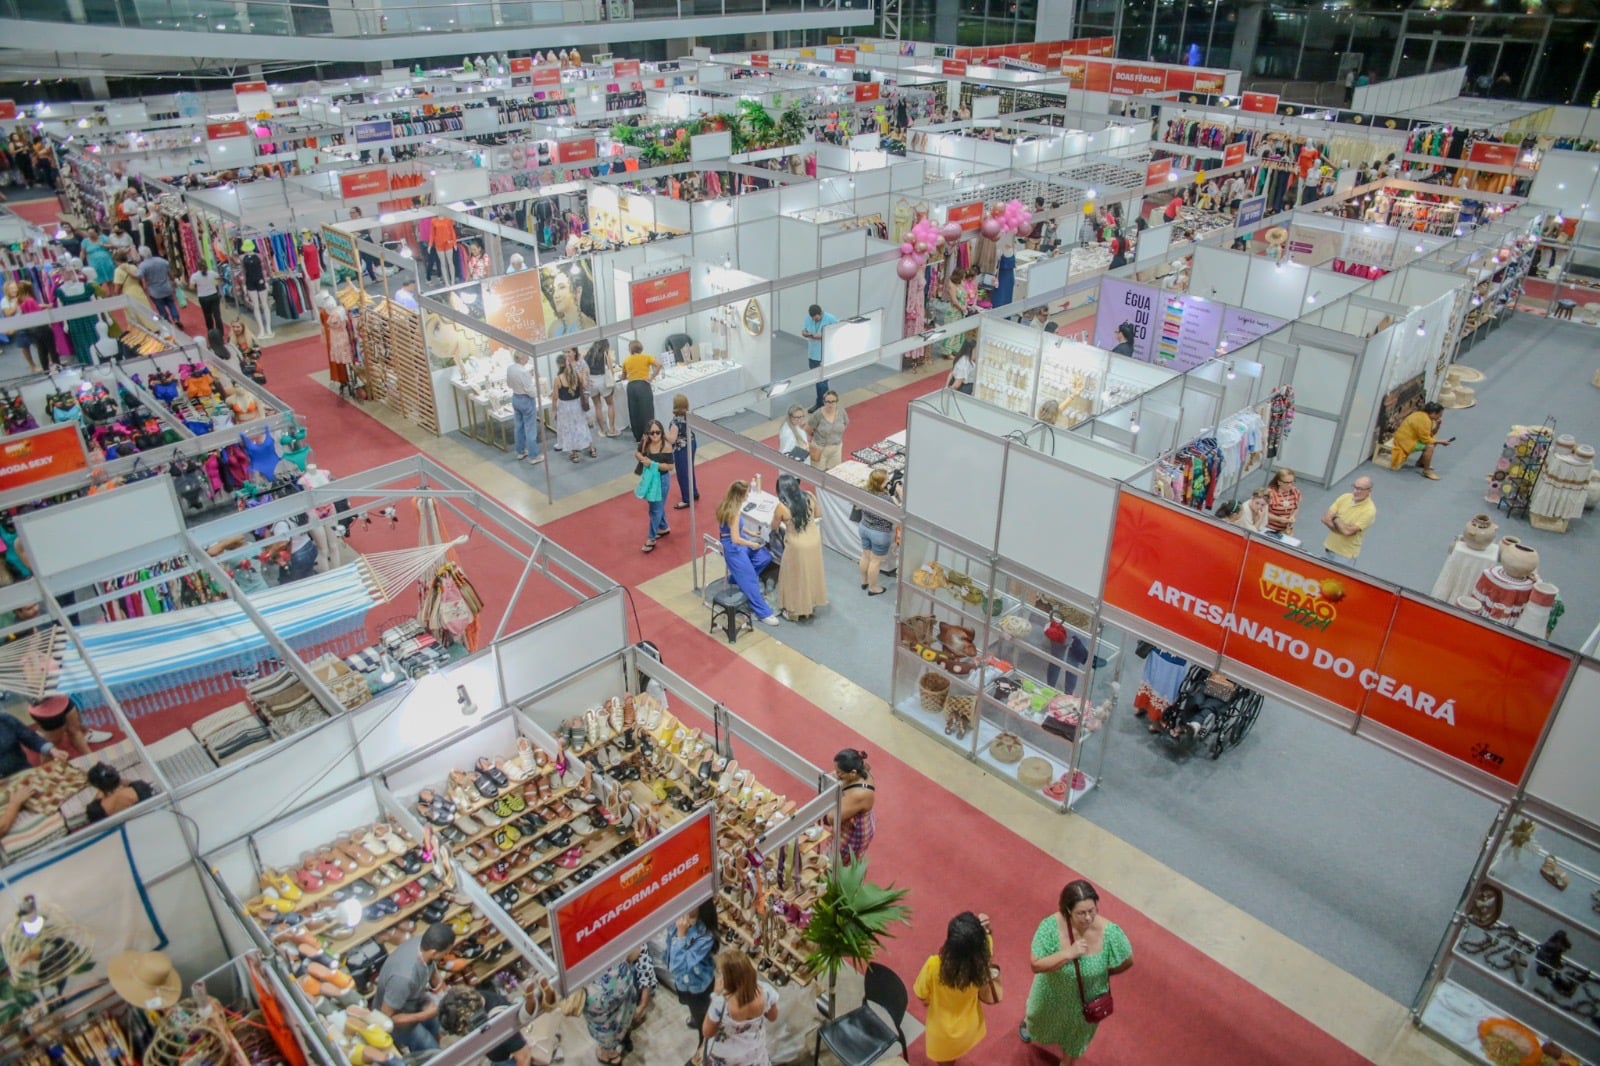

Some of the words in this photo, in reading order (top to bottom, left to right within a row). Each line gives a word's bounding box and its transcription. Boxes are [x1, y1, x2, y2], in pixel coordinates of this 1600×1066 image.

[1115, 72, 1134, 82] BOAS
[1125, 289, 1150, 311] ÉGUA
[1135, 309, 1149, 325] DU
[28, 456, 53, 469] SEXY
[1262, 562, 1321, 596] EXPO
[1259, 577, 1336, 622] VERÃO
[1283, 603, 1332, 633] 2024
[1147, 579, 1311, 661] ARTESANATO
[1311, 648, 1356, 679] DO
[1359, 667, 1456, 728] CEARÁ
[575, 880, 660, 942] PLATAFORMA
[660, 854, 700, 887] SHOES
